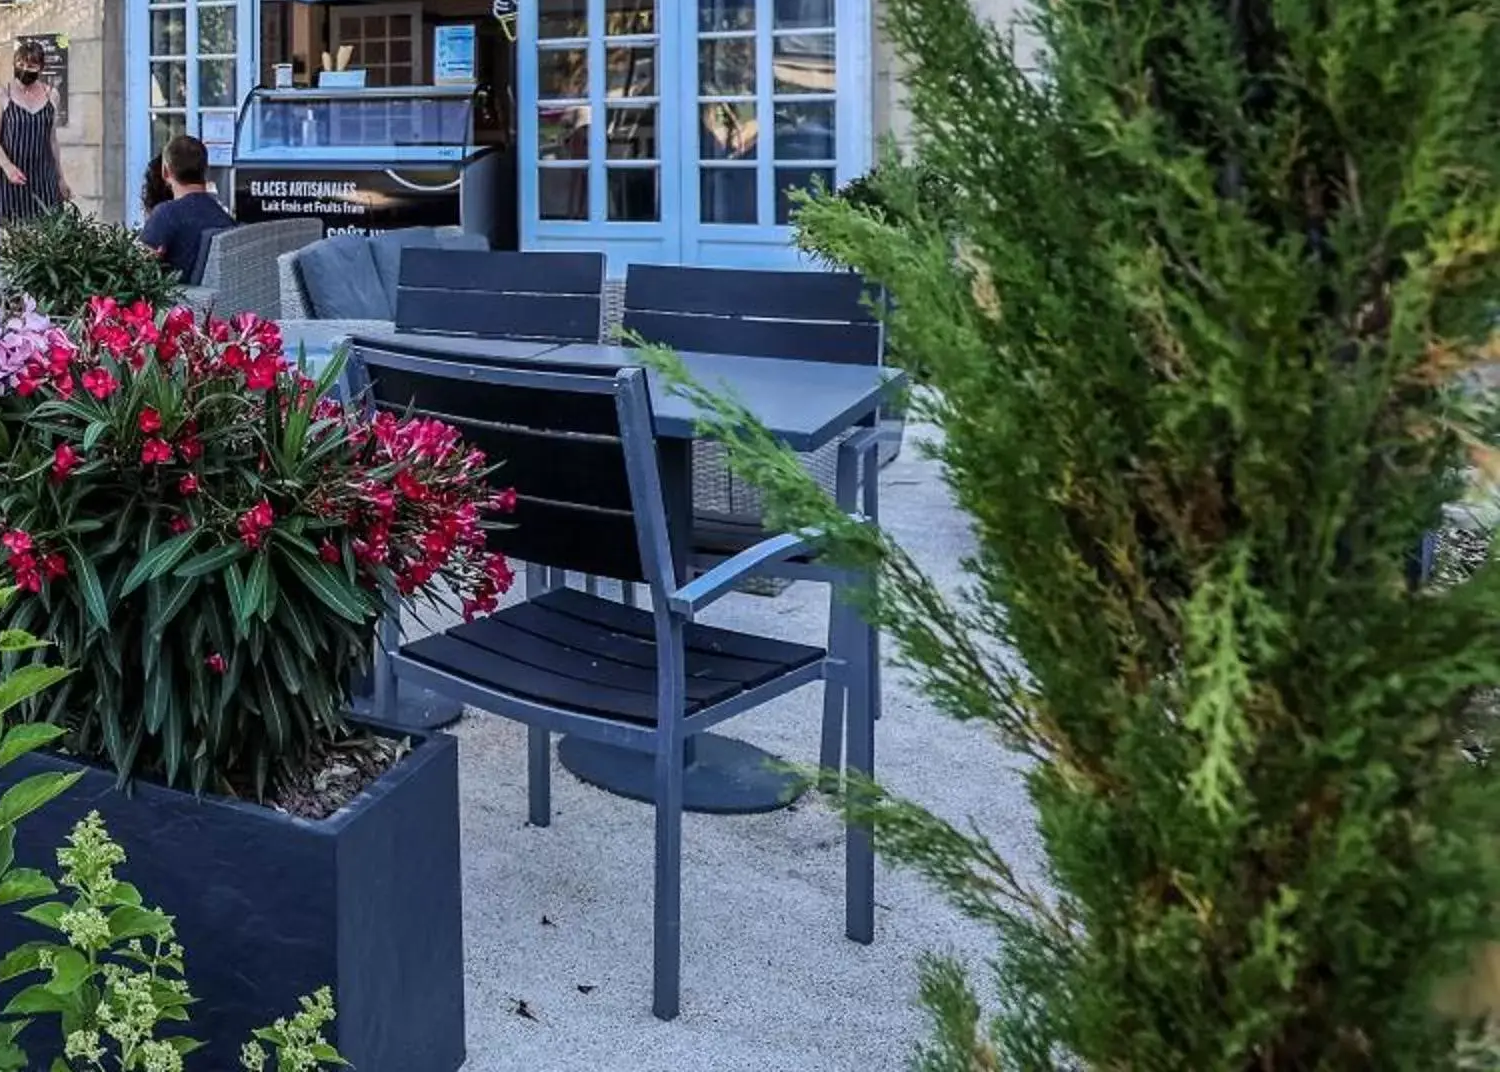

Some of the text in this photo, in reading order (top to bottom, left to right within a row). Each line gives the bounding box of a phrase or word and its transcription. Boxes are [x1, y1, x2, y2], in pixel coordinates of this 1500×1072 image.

[251, 181, 357, 197] GLACES ARTISANALES
[262, 200, 280, 211] Lait
[303, 202, 313, 213] et
[314, 201, 342, 213] Fruits
